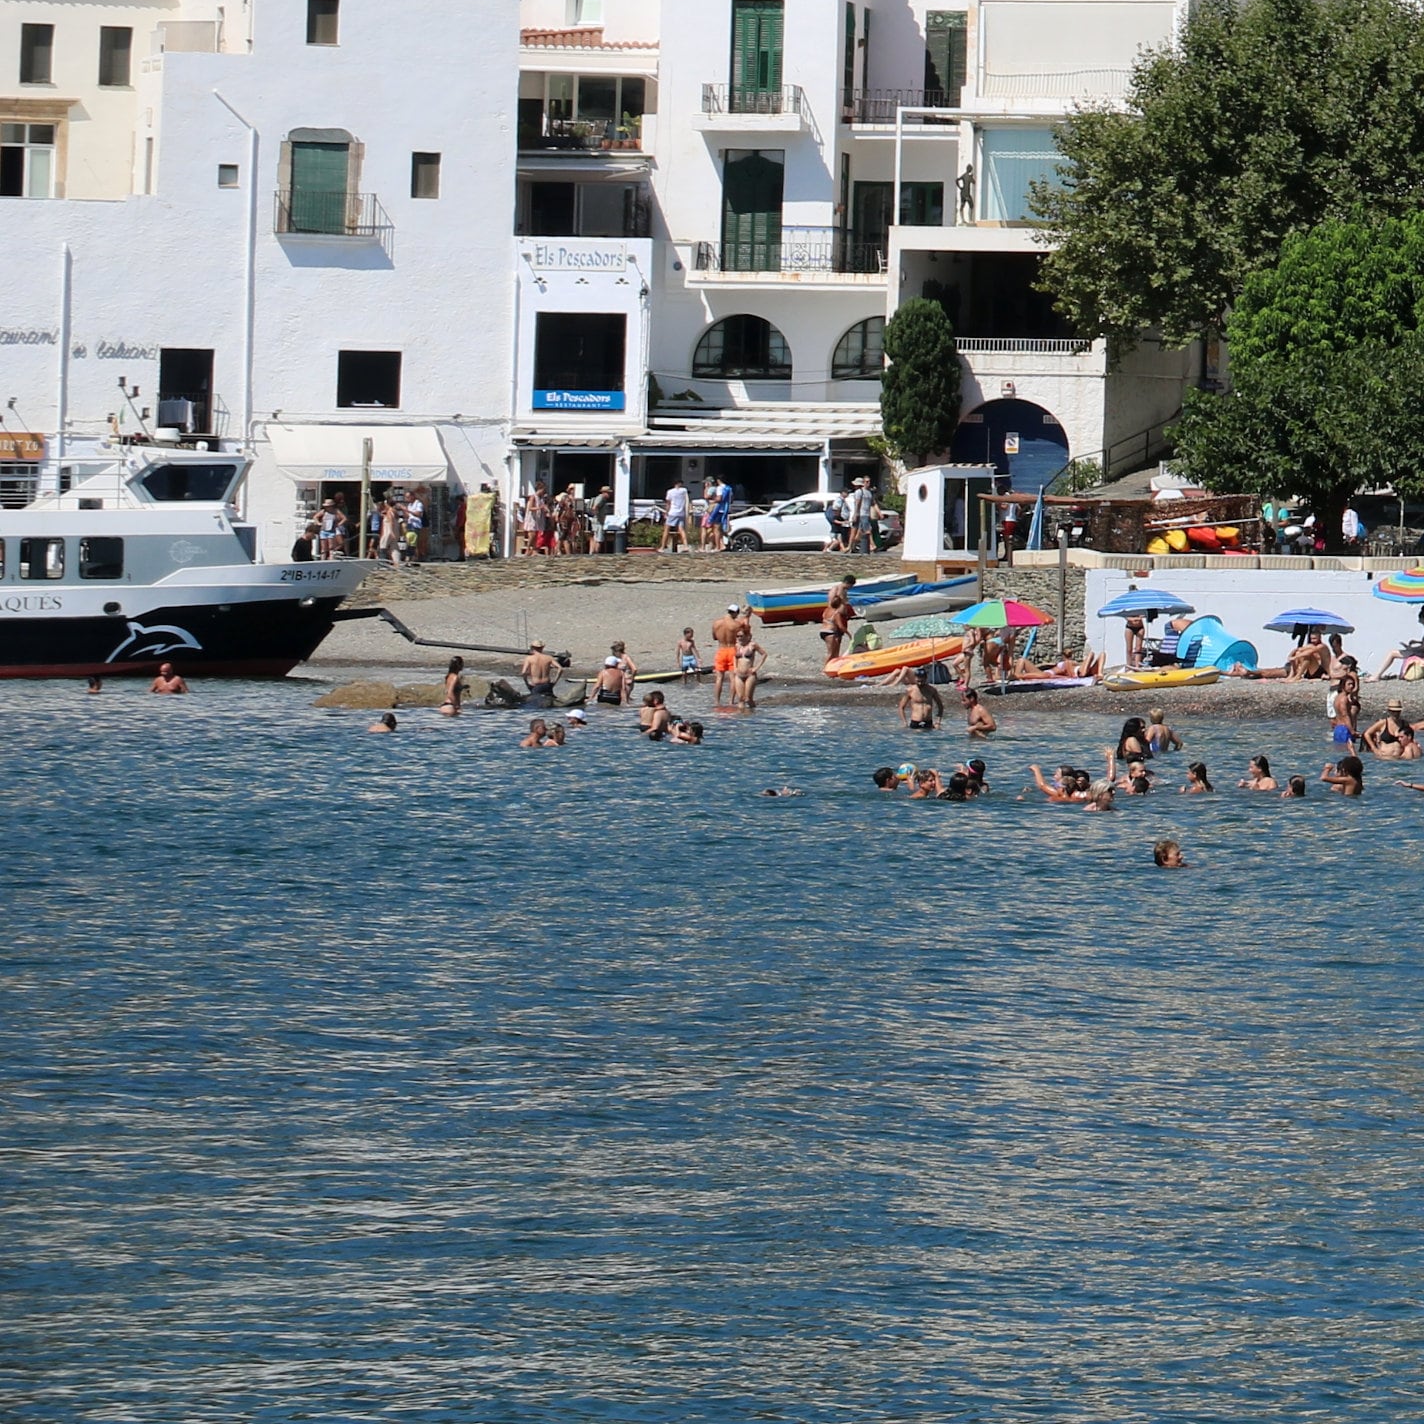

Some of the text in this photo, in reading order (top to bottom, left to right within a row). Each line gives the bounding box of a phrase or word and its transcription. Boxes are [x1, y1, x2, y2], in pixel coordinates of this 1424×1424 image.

[535, 245, 623, 268] Els Pescadors
[546, 392, 611, 403] Els Pescadors
